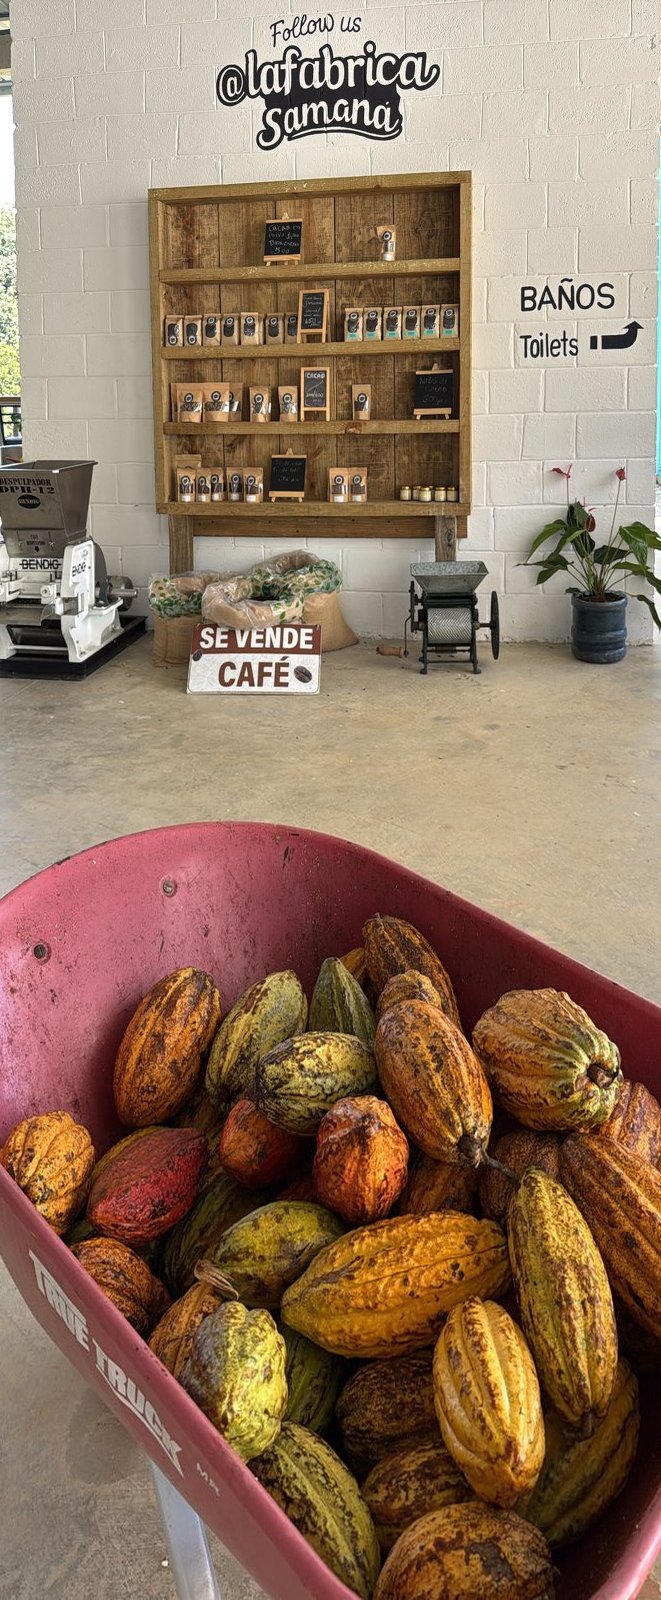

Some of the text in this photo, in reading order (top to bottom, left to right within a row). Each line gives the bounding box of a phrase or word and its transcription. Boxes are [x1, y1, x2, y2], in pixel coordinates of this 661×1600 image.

[270, 14, 362, 47] Follow us
[217, 41, 440, 106] @lafabrica
[520, 277, 616, 312] BAÑOS
[519, 330, 579, 359] Toilets
[0, 477, 52, 487] DESPULPADOR
[20, 559, 61, 570] BENDIG
[199, 626, 313, 649] SE VENDE
[218, 656, 290, 688] CAFÉ
[28, 1249, 184, 1478] TRUE TRUCK
